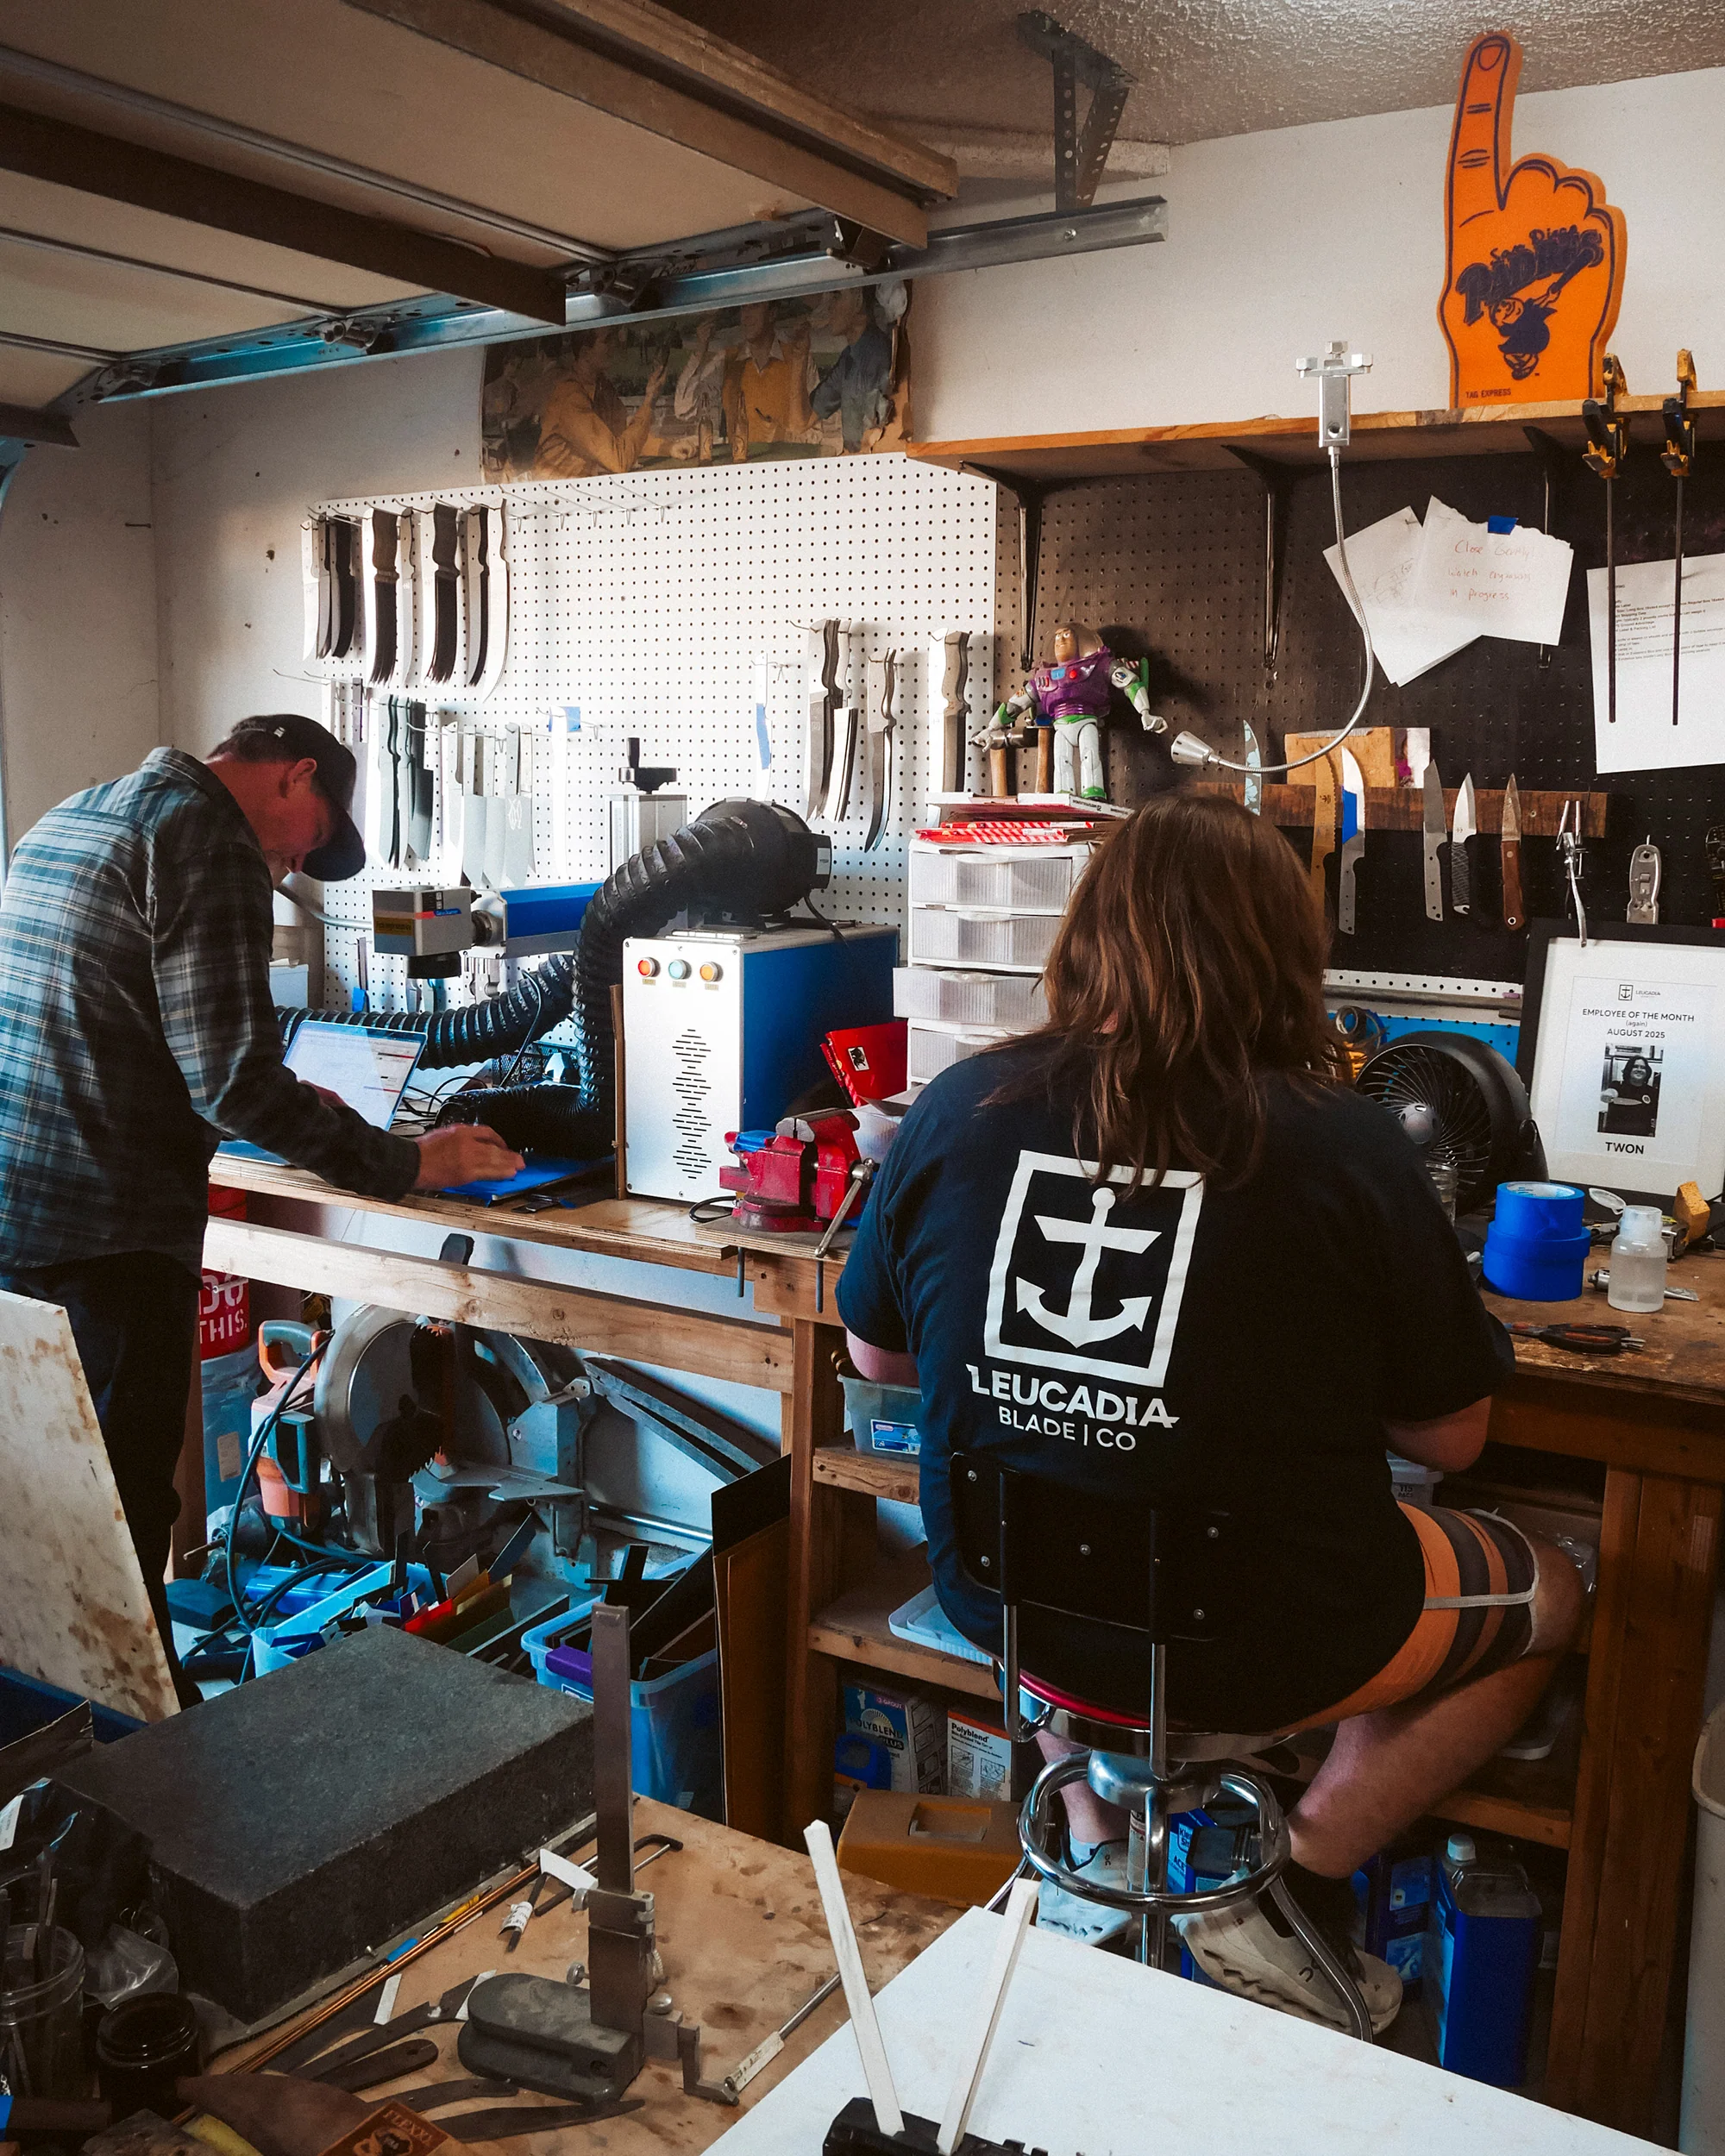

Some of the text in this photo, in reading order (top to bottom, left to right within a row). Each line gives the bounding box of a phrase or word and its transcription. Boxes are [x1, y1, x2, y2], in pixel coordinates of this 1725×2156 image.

[1454, 539, 1483, 555] Close
[1582, 1008, 1627, 1018] EMPLOYEE
[1642, 1012, 1659, 1020] THE
[1660, 1013, 1695, 1022] MONTH
[1607, 1028, 1643, 1037] AUGUST
[1605, 1141, 1645, 1155] TWON
[965, 1363, 1180, 1429] LEUCADIA
[998, 1406, 1076, 1441] BLADE
[1095, 1428, 1137, 1451] CO
[850, 1718, 904, 1739] OLYBLEND
[950, 1722, 989, 1743] Polyblend
